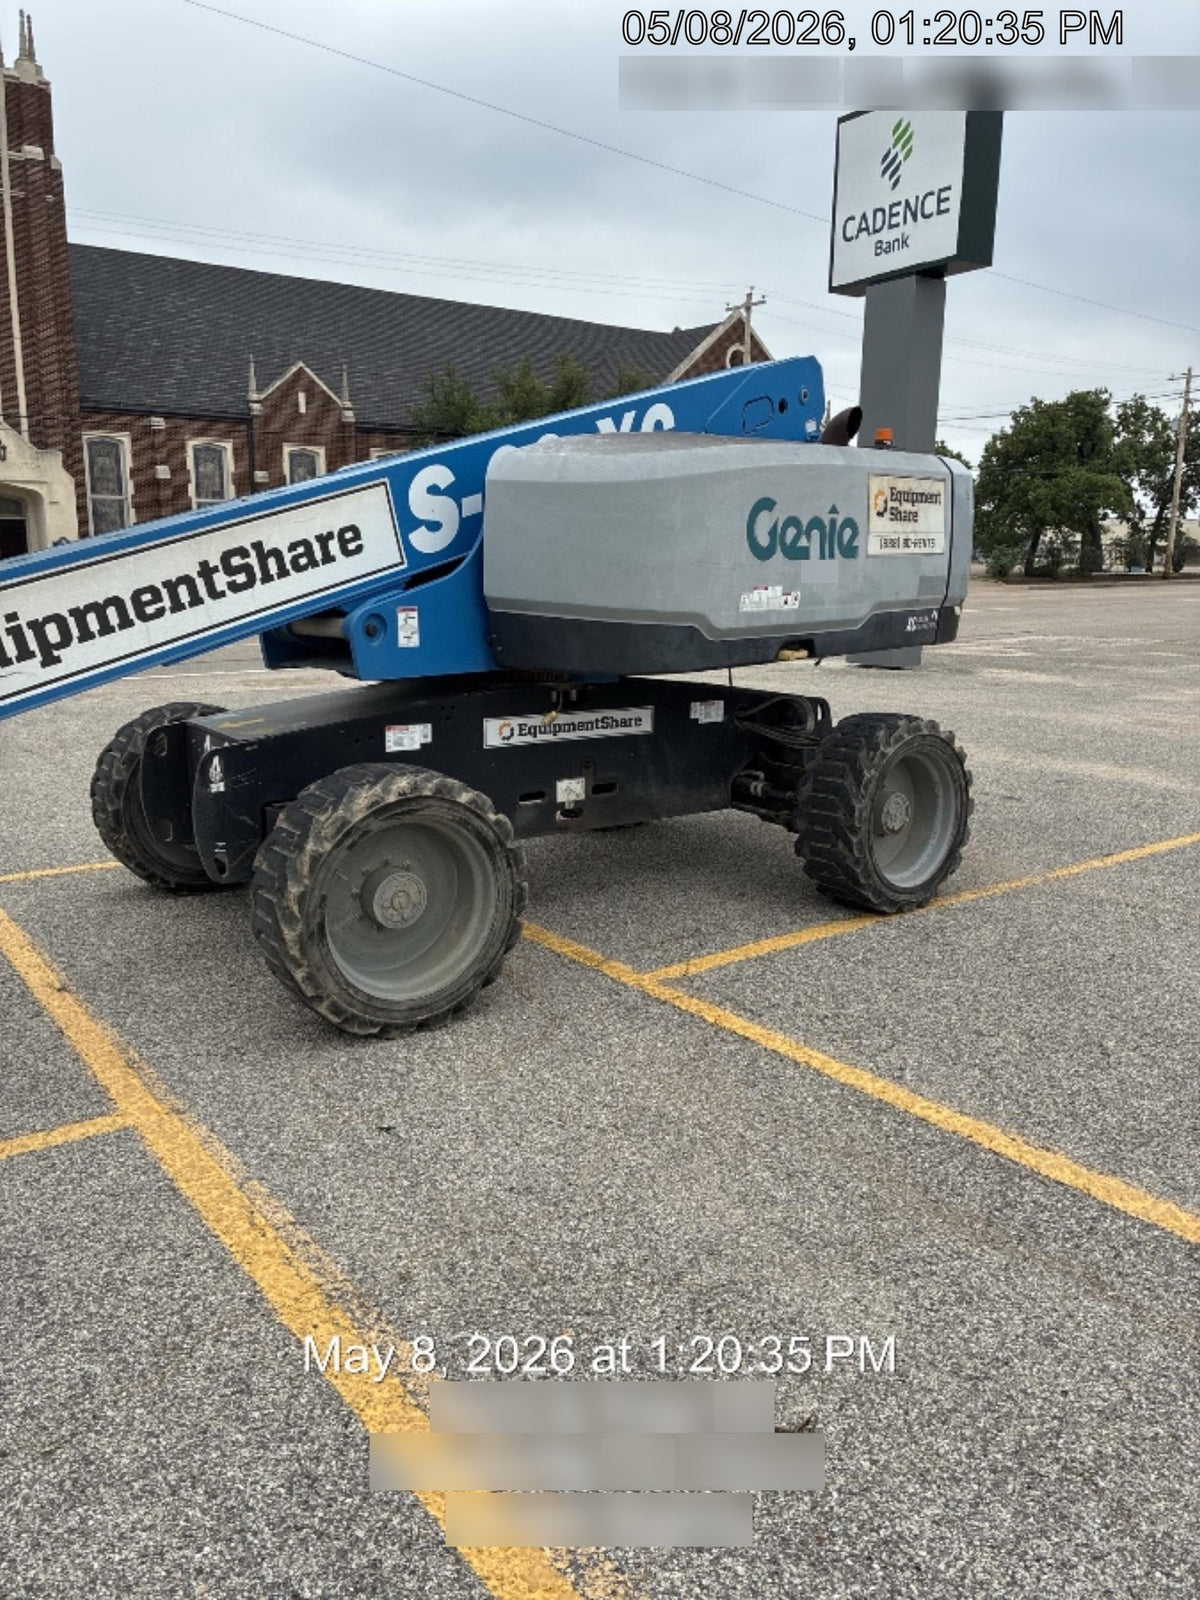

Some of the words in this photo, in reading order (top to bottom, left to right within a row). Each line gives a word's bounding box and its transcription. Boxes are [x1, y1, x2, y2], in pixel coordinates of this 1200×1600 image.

[842, 185, 952, 242] CADENCE
[874, 232, 910, 257] Bank
[889, 486, 942, 507] Equipment
[889, 506, 919, 523] Share
[746, 497, 860, 561] Genie
[517, 715, 643, 739] EquipmentShare
